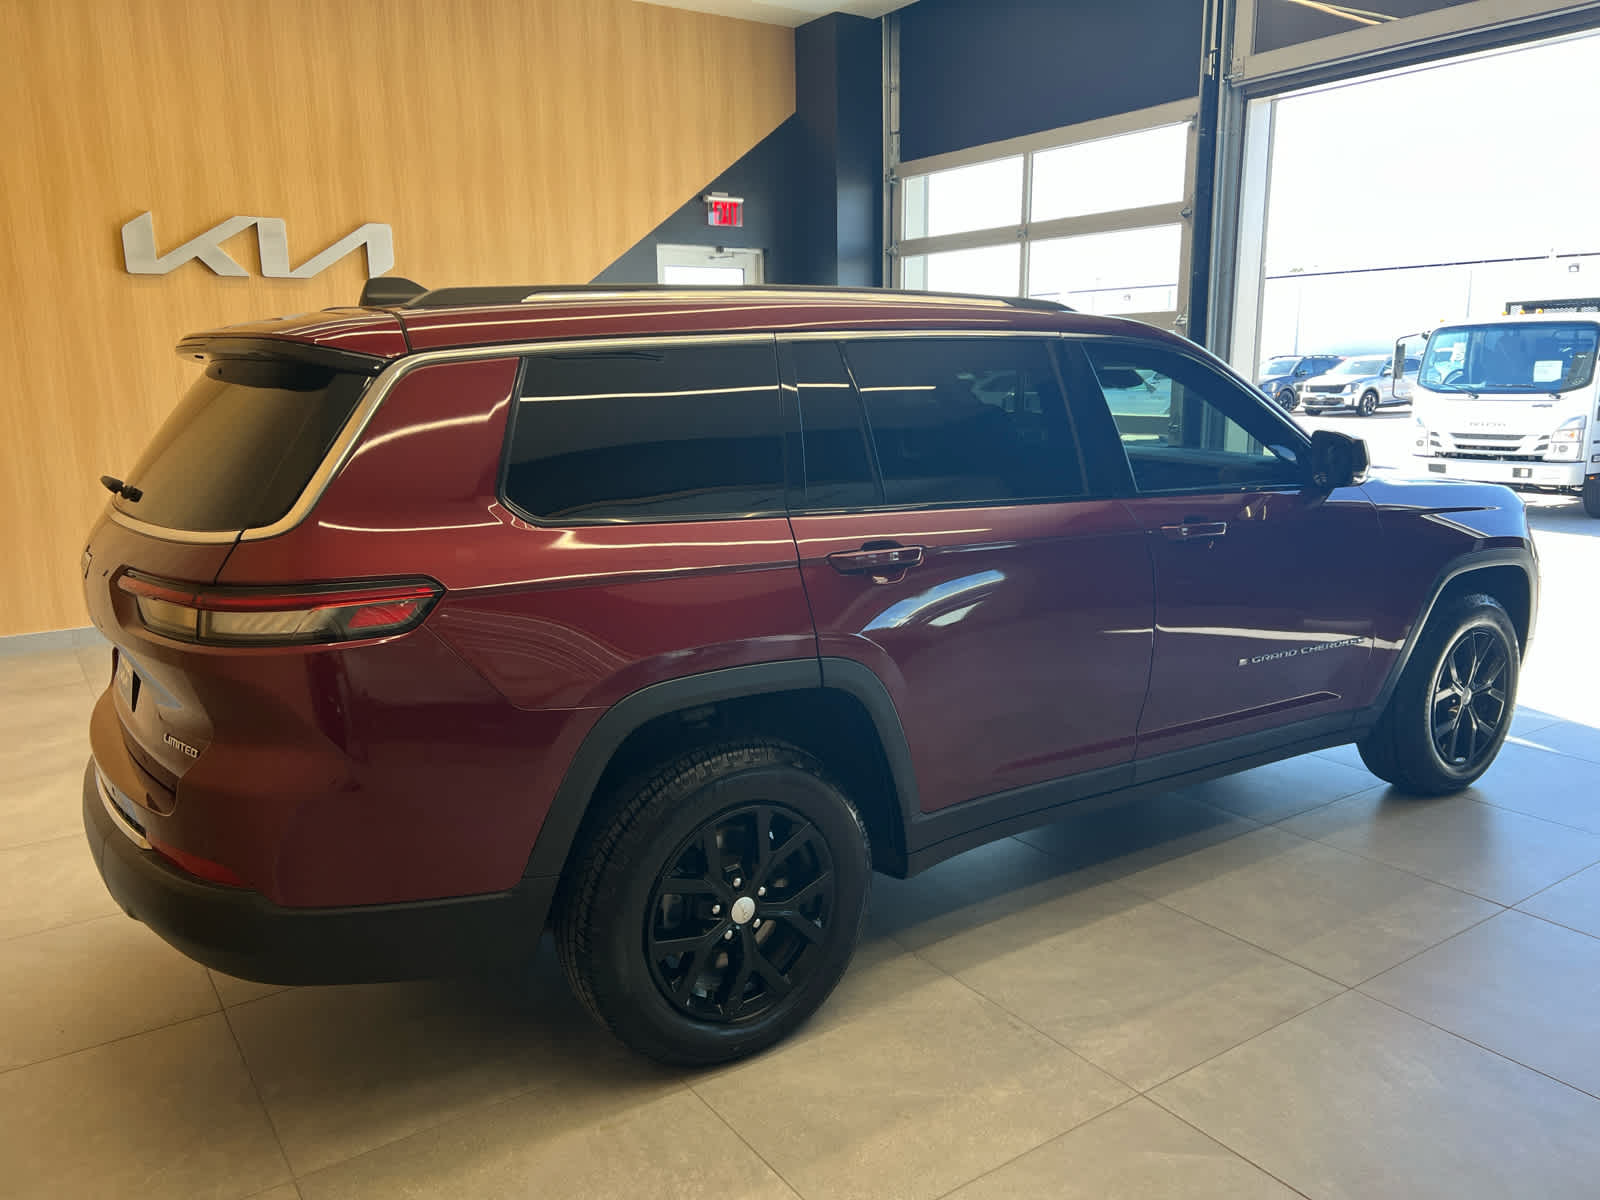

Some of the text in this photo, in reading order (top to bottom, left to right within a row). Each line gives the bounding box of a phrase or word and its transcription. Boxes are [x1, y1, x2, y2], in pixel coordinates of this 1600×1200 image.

[713, 201, 739, 226] EXIT
[121, 210, 394, 279] KIA
[1251, 649, 1297, 663] GRAND
[163, 733, 199, 759] LIMITED
